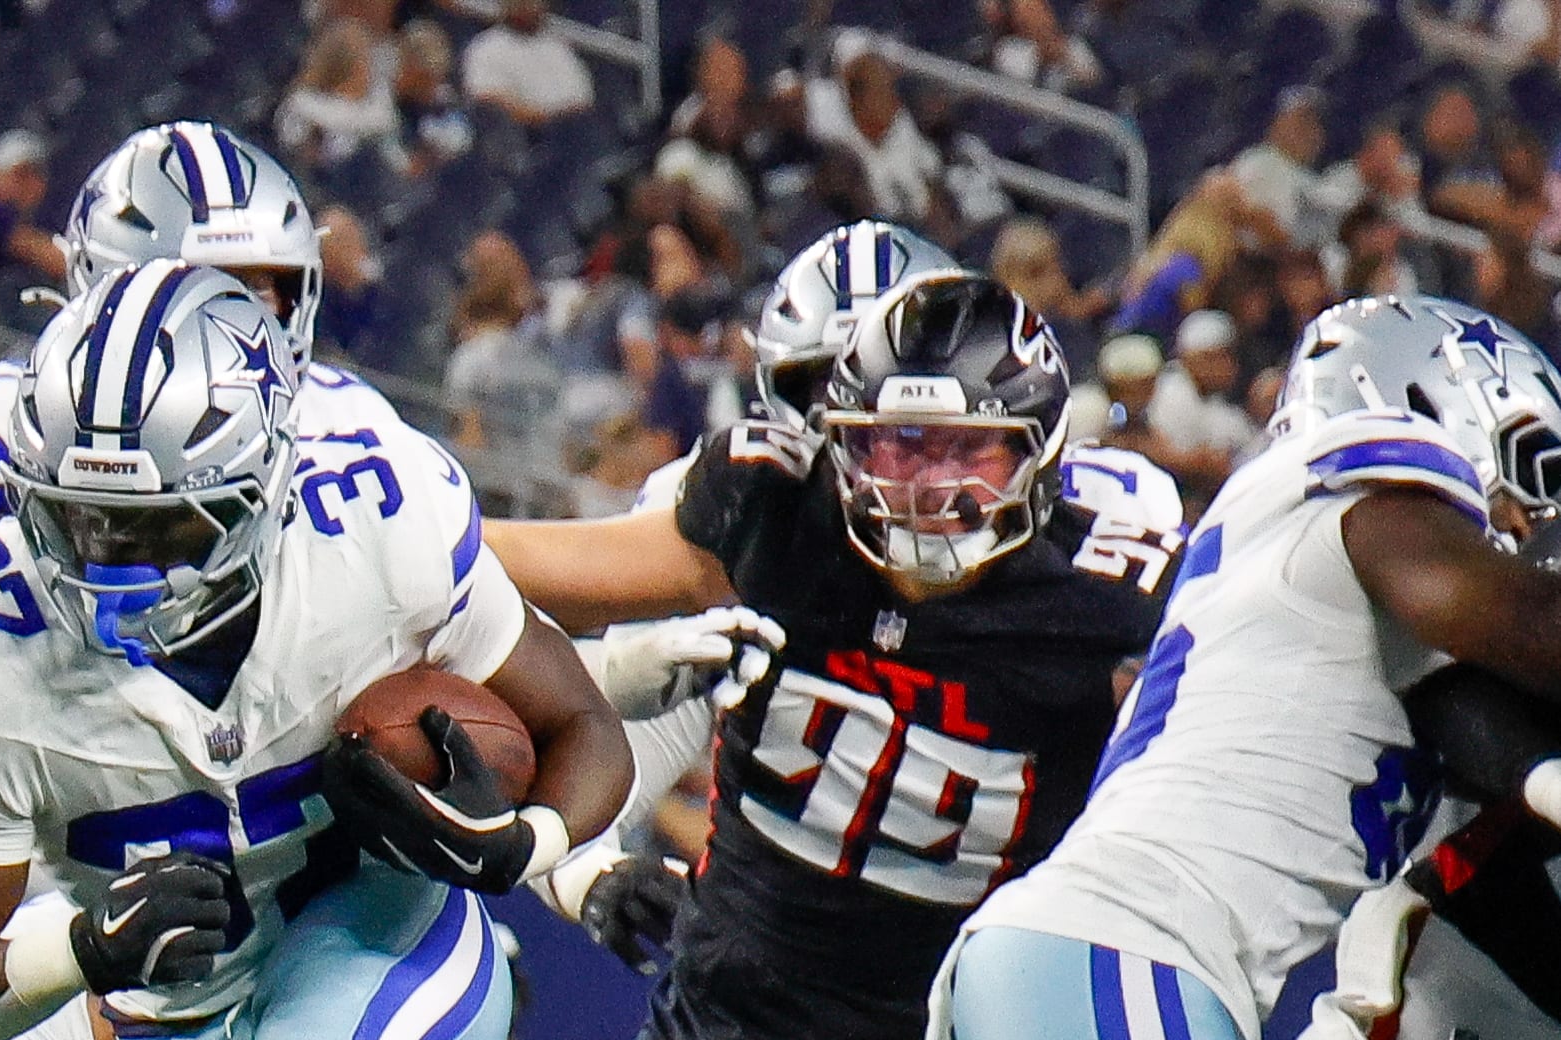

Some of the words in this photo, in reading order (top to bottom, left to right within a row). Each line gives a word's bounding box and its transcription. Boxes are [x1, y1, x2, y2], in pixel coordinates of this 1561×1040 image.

[900, 383, 939, 399] ATL
[73, 459, 139, 475] COWBOYS
[826, 650, 991, 742] ATL
[739, 668, 1037, 908] 99
